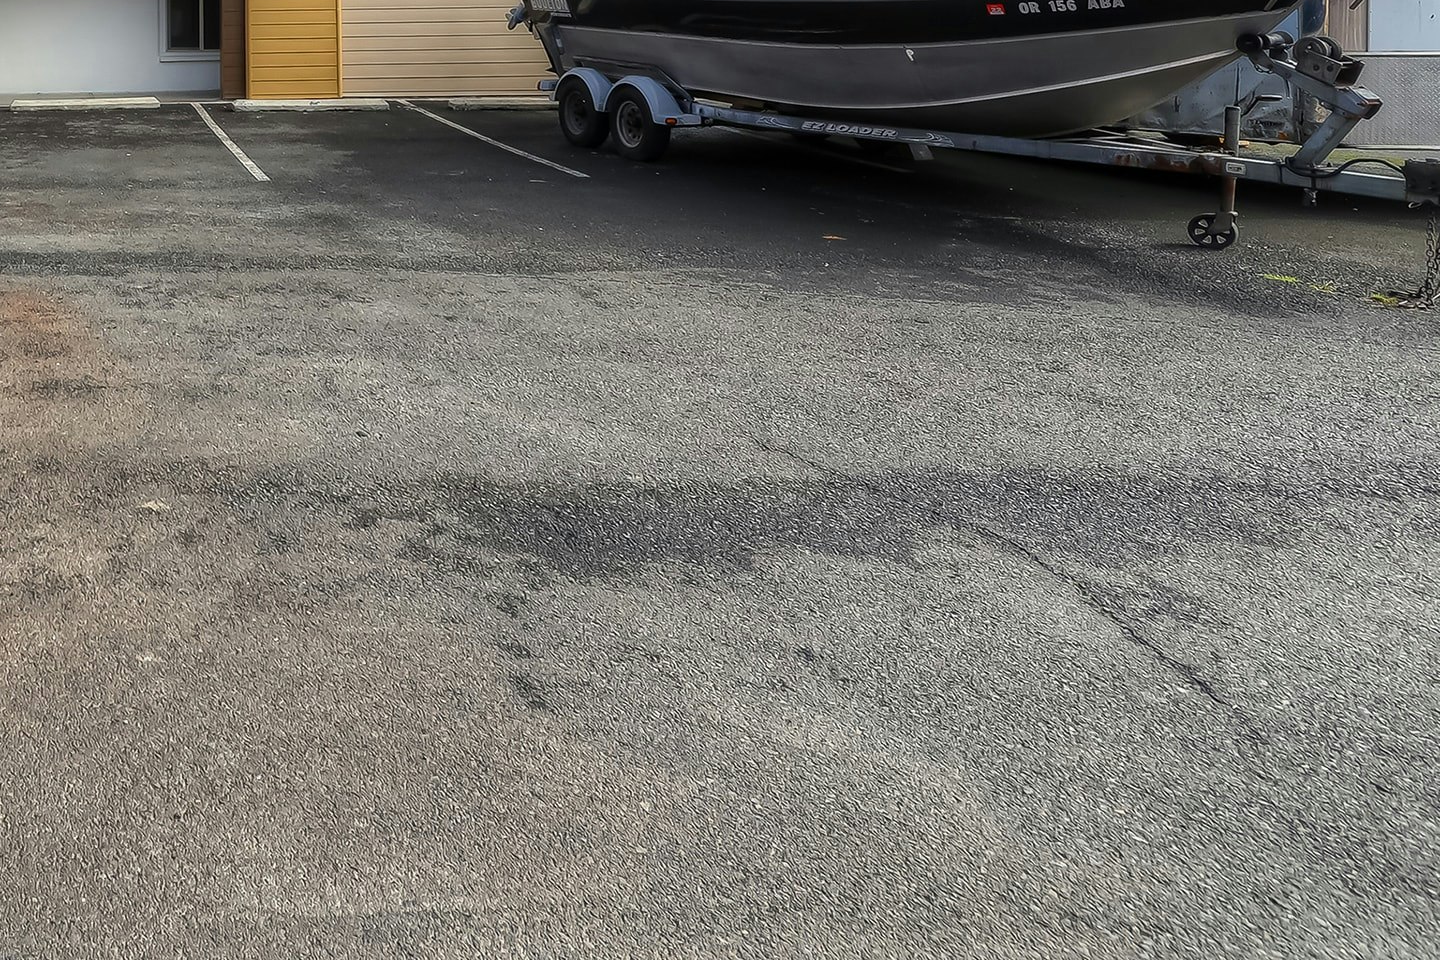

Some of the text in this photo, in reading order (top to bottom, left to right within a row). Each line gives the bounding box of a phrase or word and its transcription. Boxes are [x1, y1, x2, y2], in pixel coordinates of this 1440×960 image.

[1018, 1, 1041, 14] OR
[1048, 0, 1078, 12] 156
[801, 121, 898, 139] EZ LOADER
